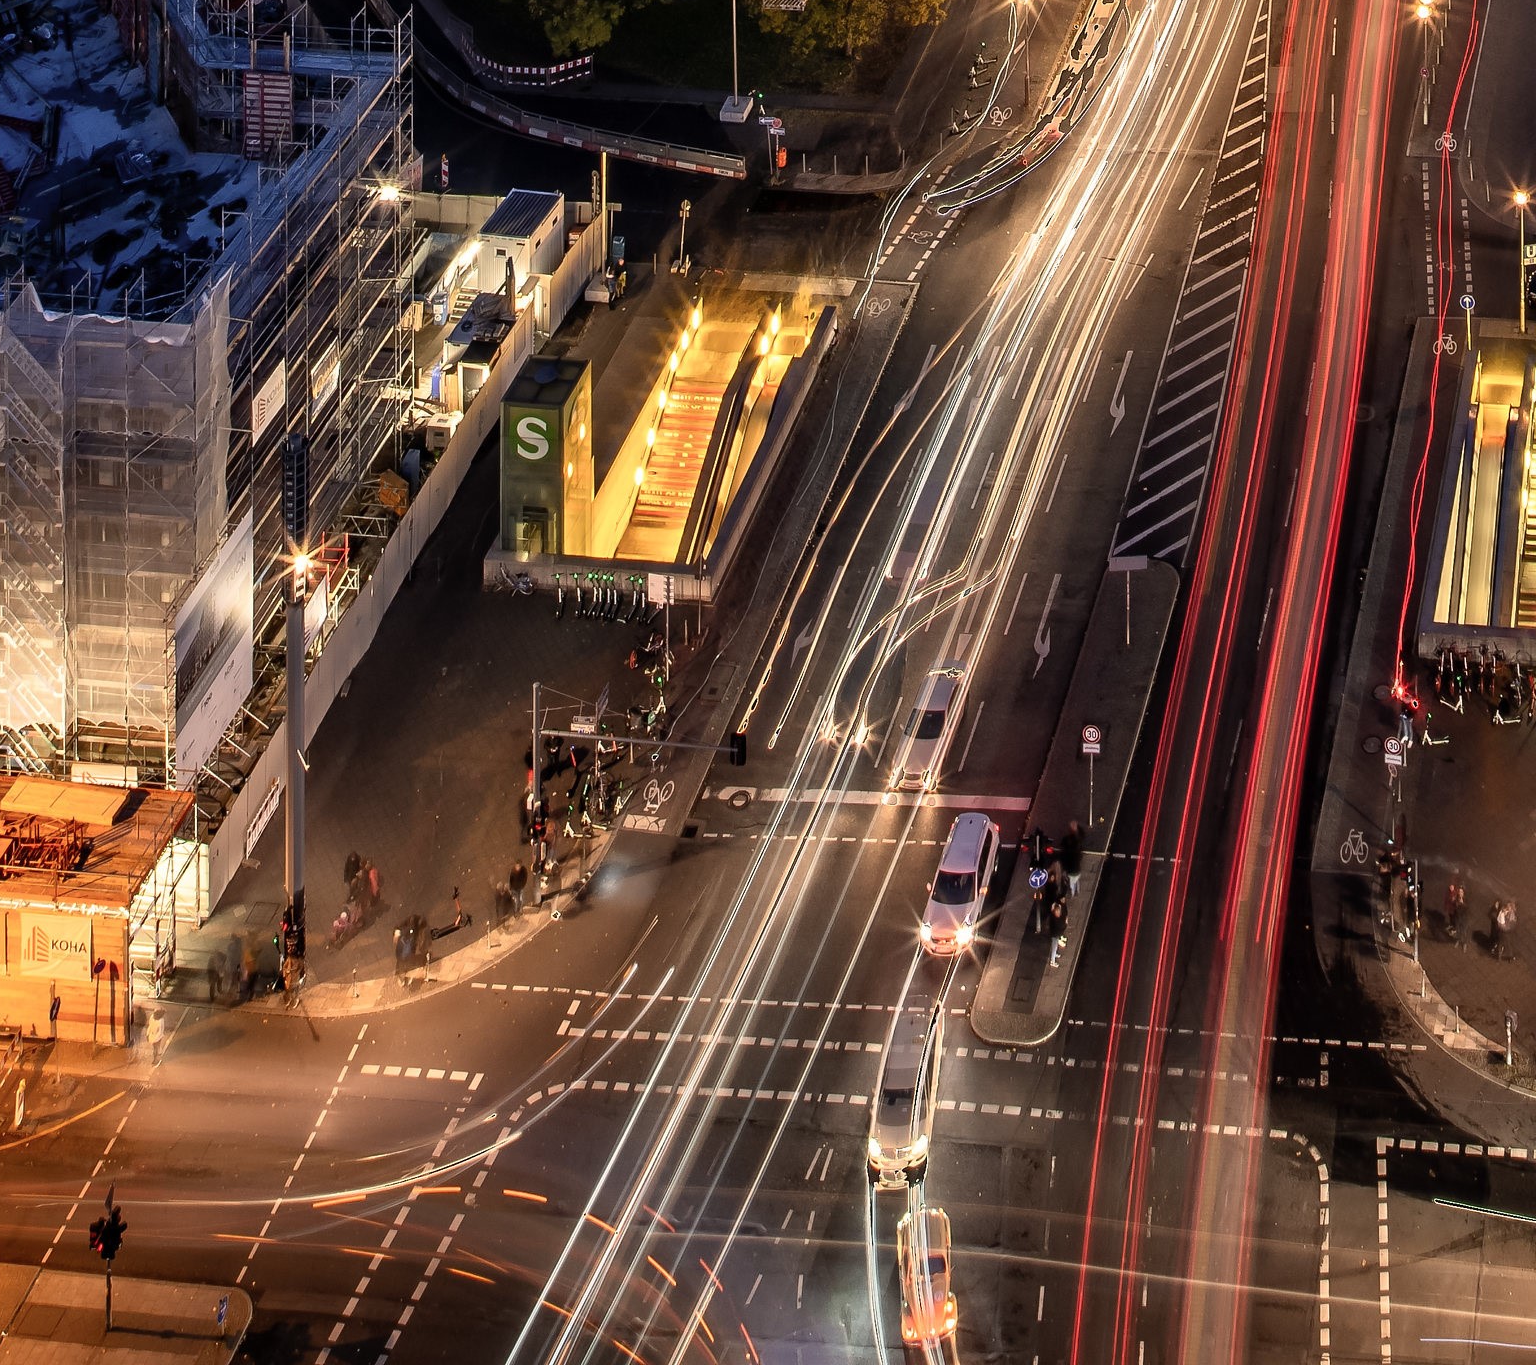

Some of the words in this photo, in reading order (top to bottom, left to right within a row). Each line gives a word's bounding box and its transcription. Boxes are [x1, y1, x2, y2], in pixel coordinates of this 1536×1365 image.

[516, 416, 550, 461] S
[1086, 730, 1097, 739] 30
[1388, 741, 1399, 751] 30
